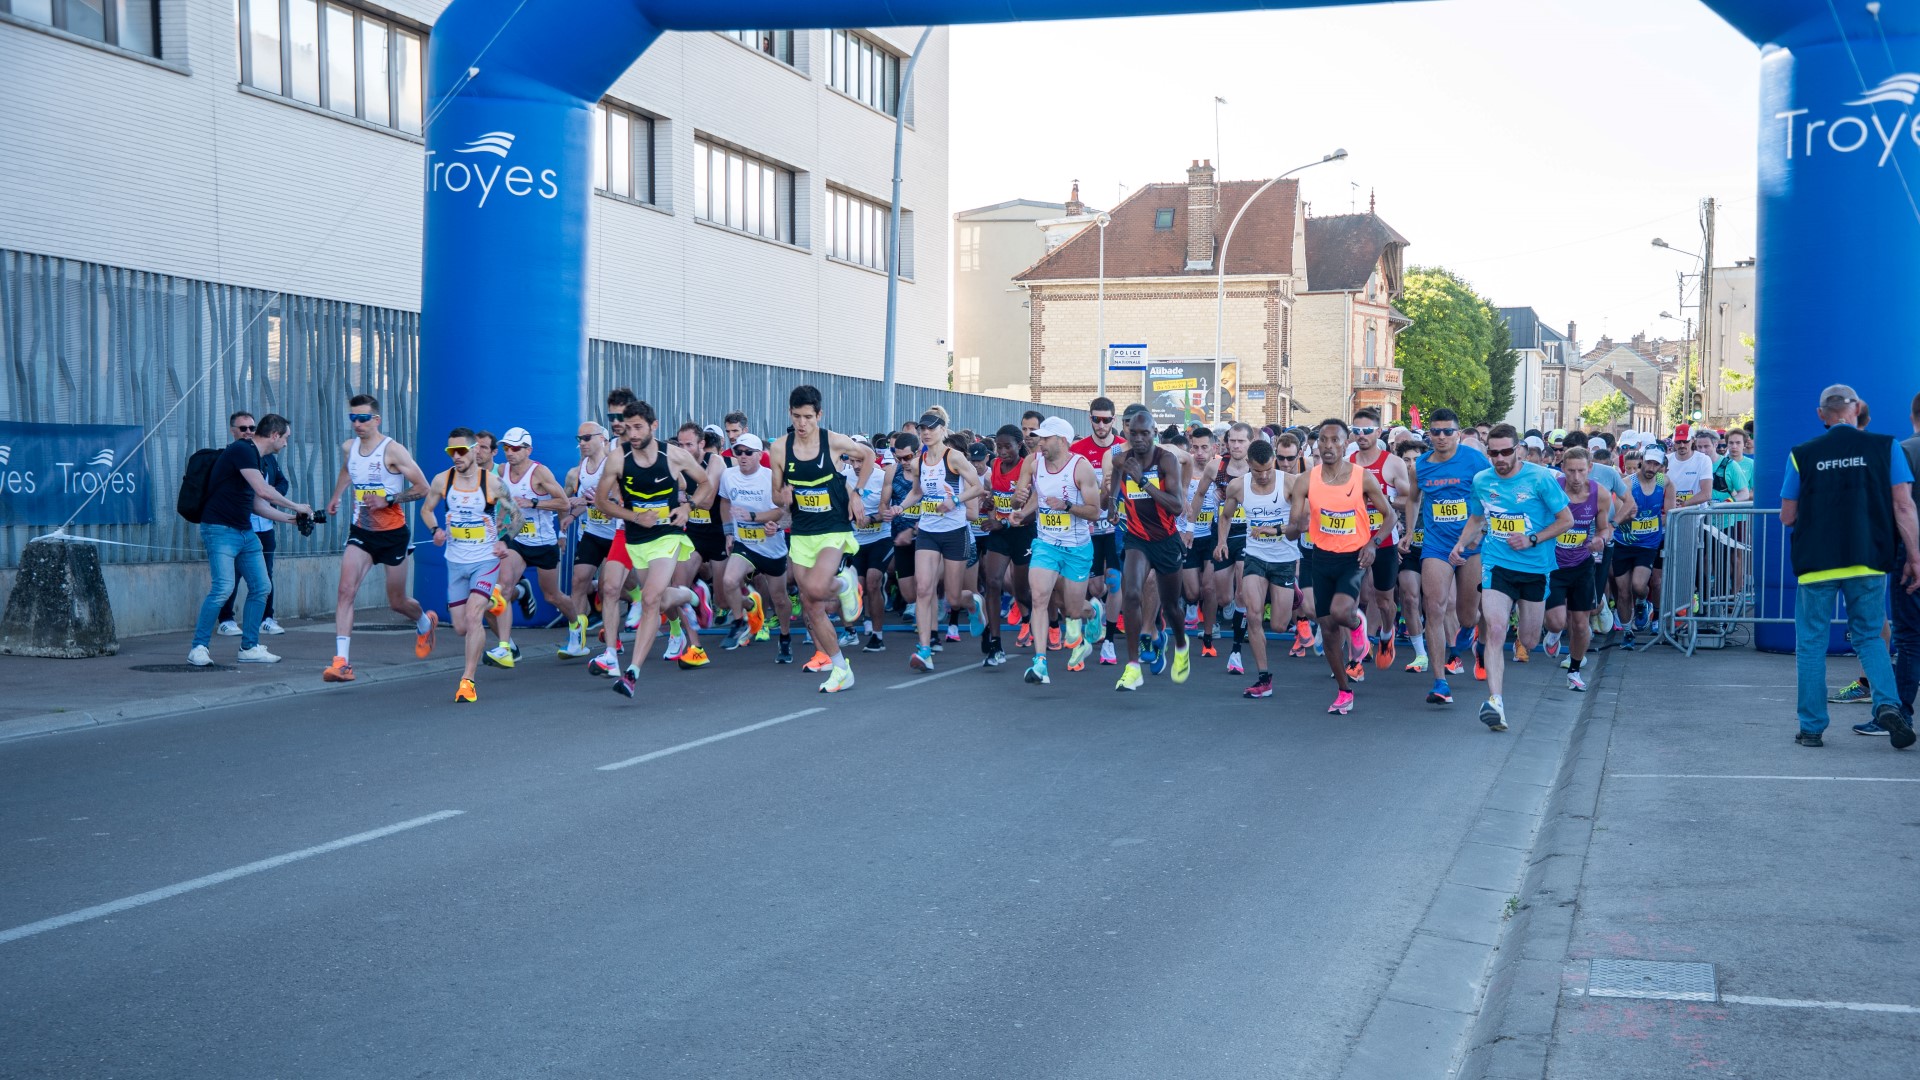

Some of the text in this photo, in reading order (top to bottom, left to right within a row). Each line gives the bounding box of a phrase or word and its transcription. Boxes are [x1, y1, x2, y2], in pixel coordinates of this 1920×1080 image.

[425, 150, 558, 208] Troyes
[1149, 366, 1184, 375] Aubade
[1816, 456, 1867, 471] OFFICIEL
[55, 462, 136, 505] Troyes
[803, 495, 820, 507] 597
[1252, 507, 1282, 518] Plus
[1440, 504, 1458, 516] 466
[1045, 514, 1062, 526] 684
[1329, 517, 1346, 529] 797
[1496, 520, 1515, 532] 240
[1639, 521, 1653, 530] 703
[464, 528, 471, 539] 5
[743, 529, 757, 539] 154
[1563, 534, 1577, 544] 176
